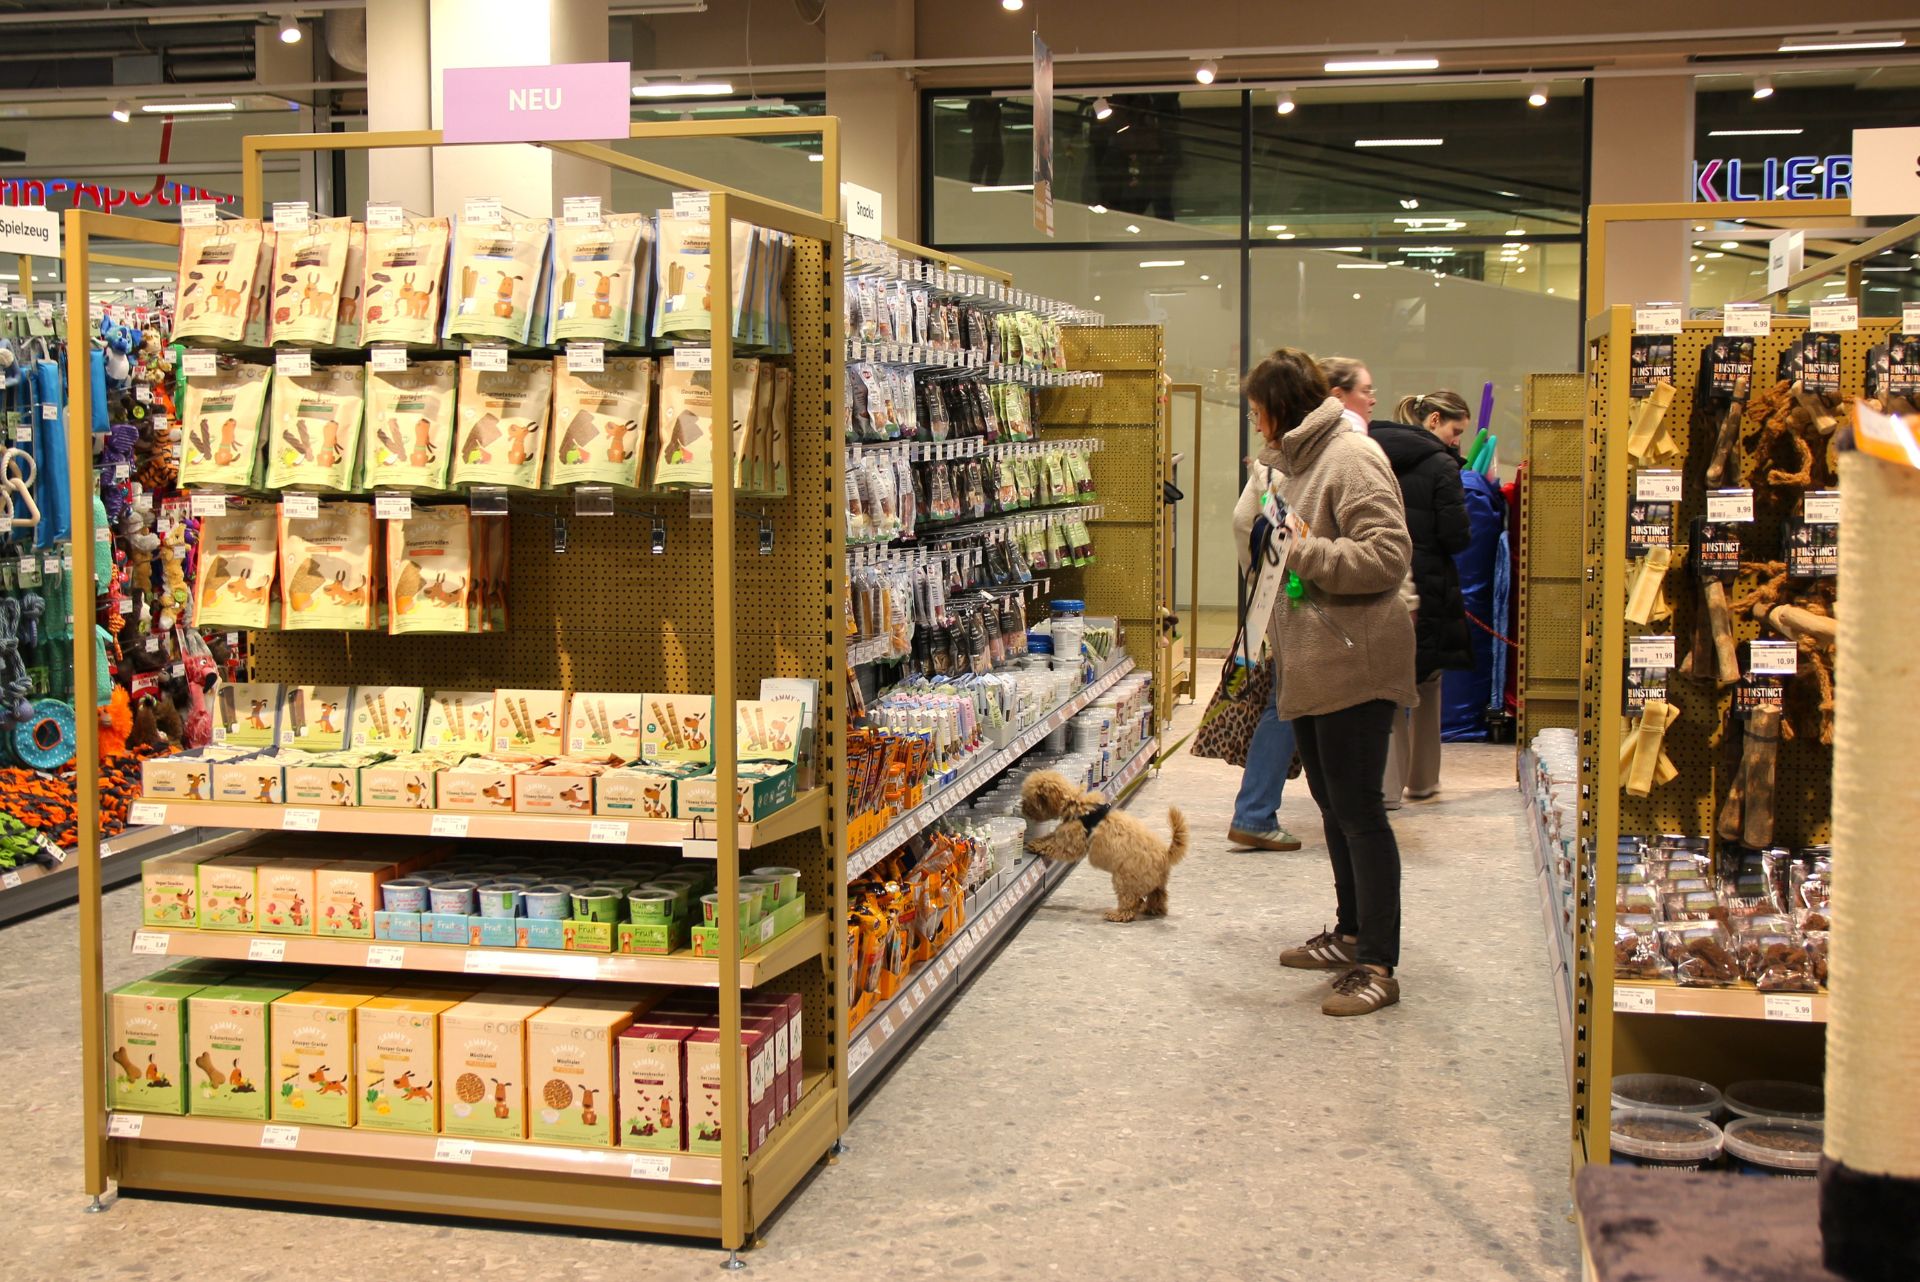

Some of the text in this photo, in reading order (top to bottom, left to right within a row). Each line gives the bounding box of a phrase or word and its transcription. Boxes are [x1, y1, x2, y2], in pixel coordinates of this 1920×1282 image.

[509, 88, 562, 111] NEU
[1692, 154, 1853, 203] KLIER
[856, 201, 874, 220] Snacks
[1637, 366, 1671, 376] INSTINCT
[1719, 363, 1752, 374] INSTINCT
[1808, 363, 1840, 374] INSTINCT
[1635, 525, 1670, 536] INSTINCT
[1706, 542, 1741, 553] INSTINCT
[1801, 546, 1838, 557] INSTINCT
[1632, 687, 1667, 699] INSTINCT
[1749, 687, 1783, 698] INSTINCT
